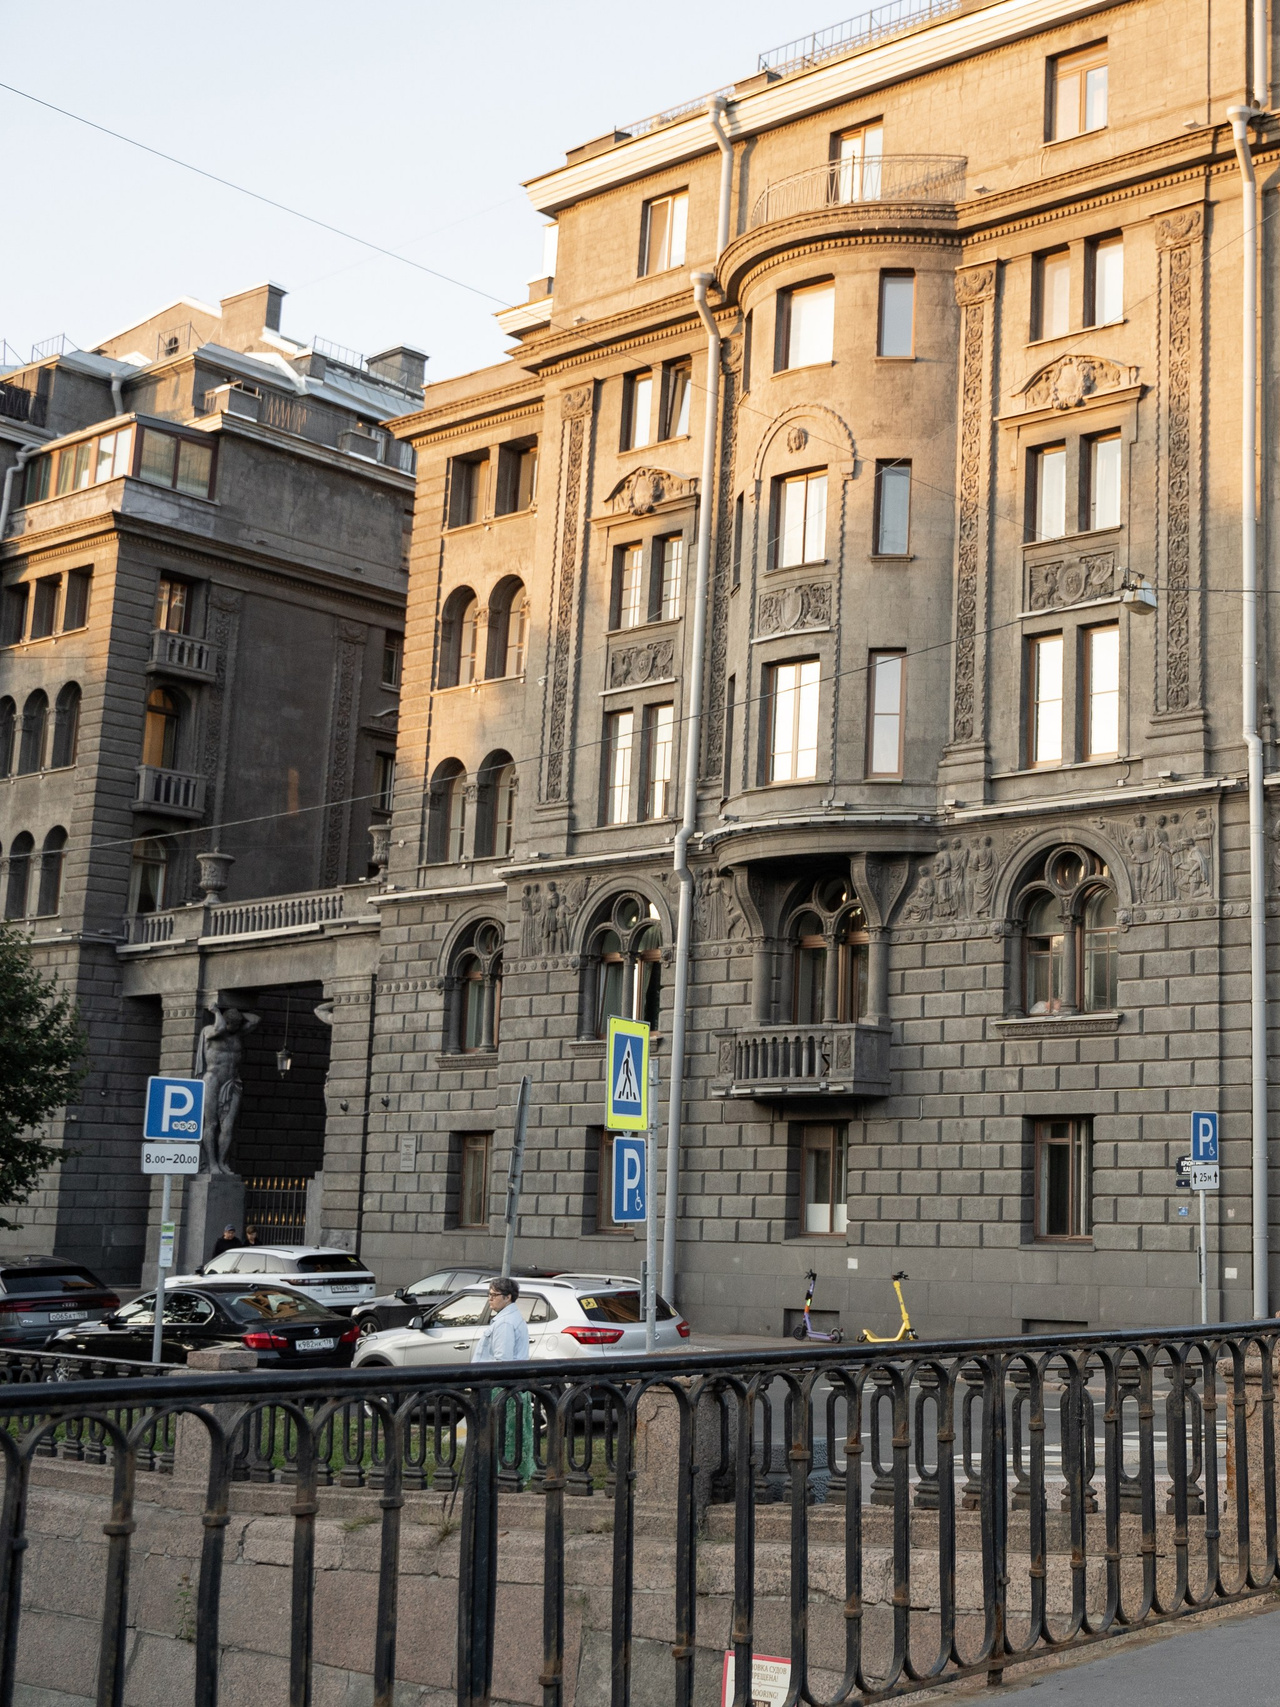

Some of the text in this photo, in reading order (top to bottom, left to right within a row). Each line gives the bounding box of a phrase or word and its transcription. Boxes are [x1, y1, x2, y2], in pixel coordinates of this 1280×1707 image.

[161, 1085, 194, 1132] P
[187, 1122, 197, 1130] 20
[1199, 1118, 1213, 1156] P
[623, 1148, 641, 1211] P
[769, 1665, 787, 1675] СУДОВ
